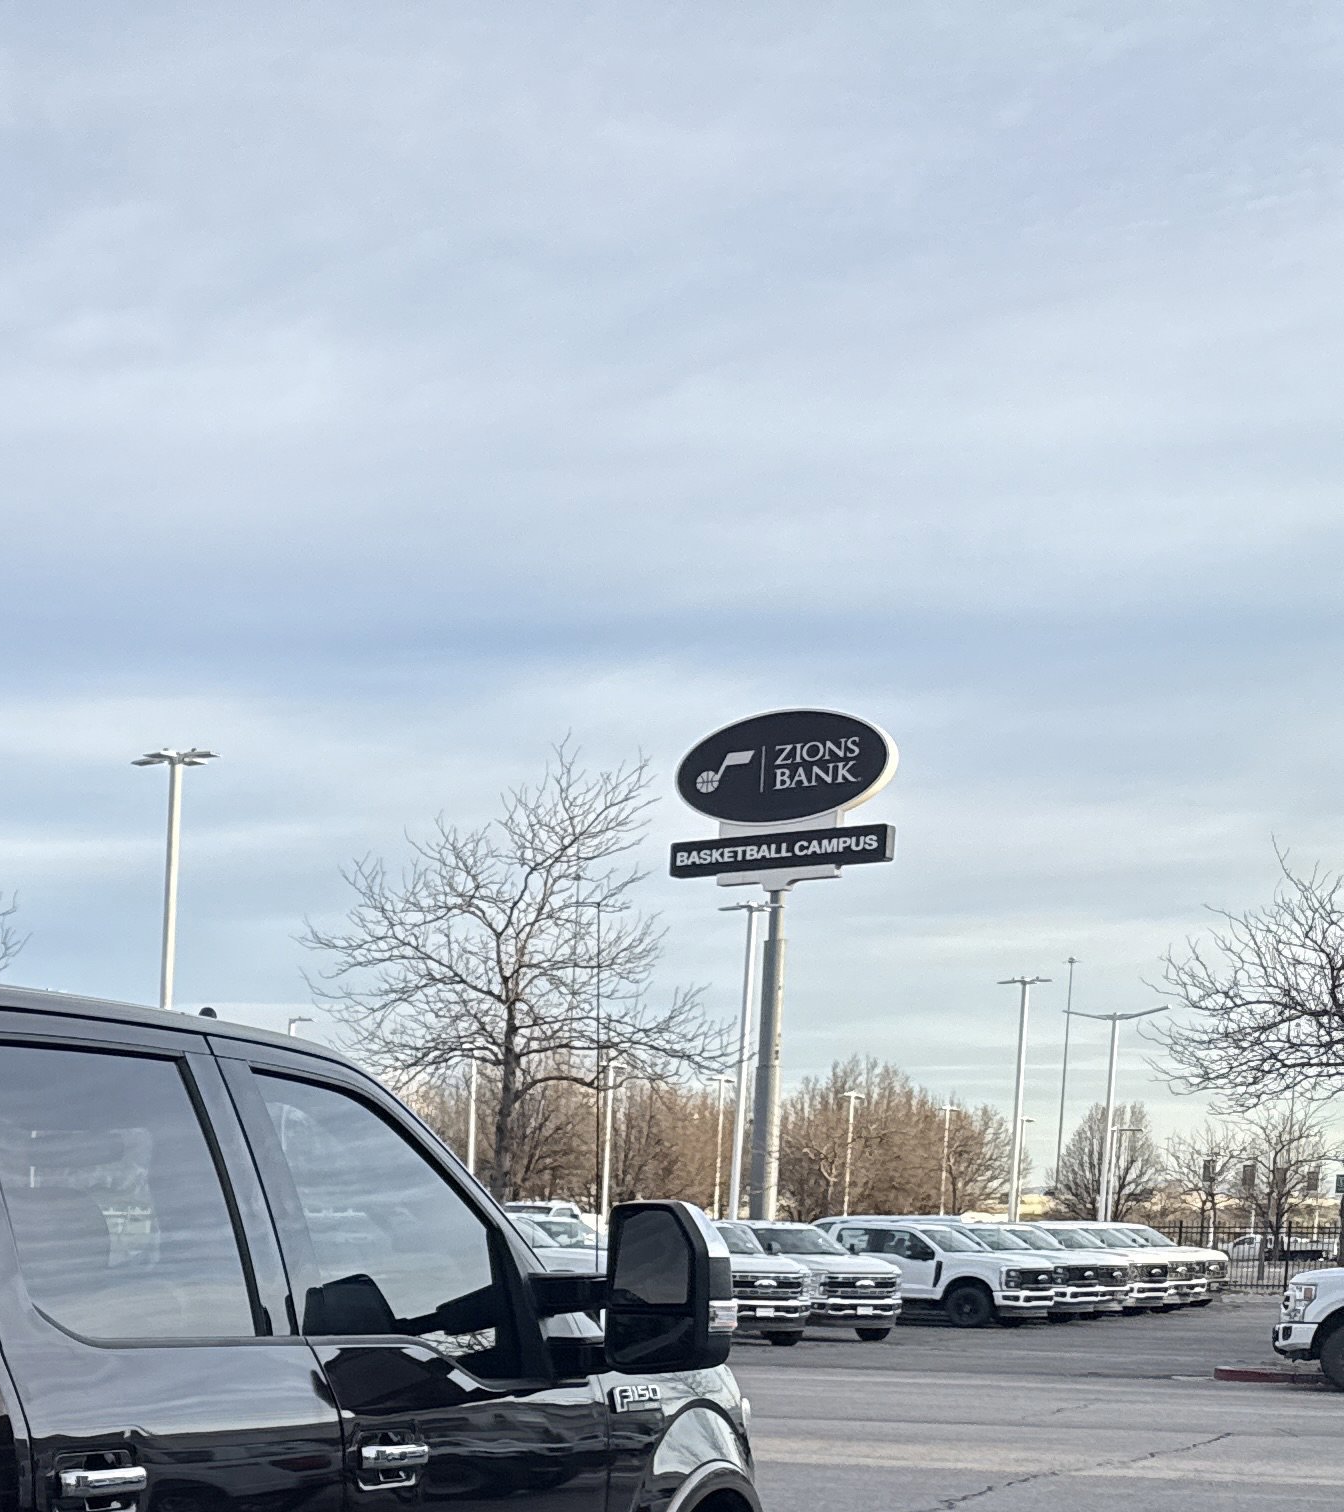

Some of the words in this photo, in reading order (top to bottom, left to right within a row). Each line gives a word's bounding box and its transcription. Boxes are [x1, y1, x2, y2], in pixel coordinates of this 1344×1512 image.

[774, 737, 860, 766] ZIONS
[773, 761, 859, 791] BANK
[676, 843, 792, 867] BASKETBALL
[794, 834, 878, 856] CAMPUS
